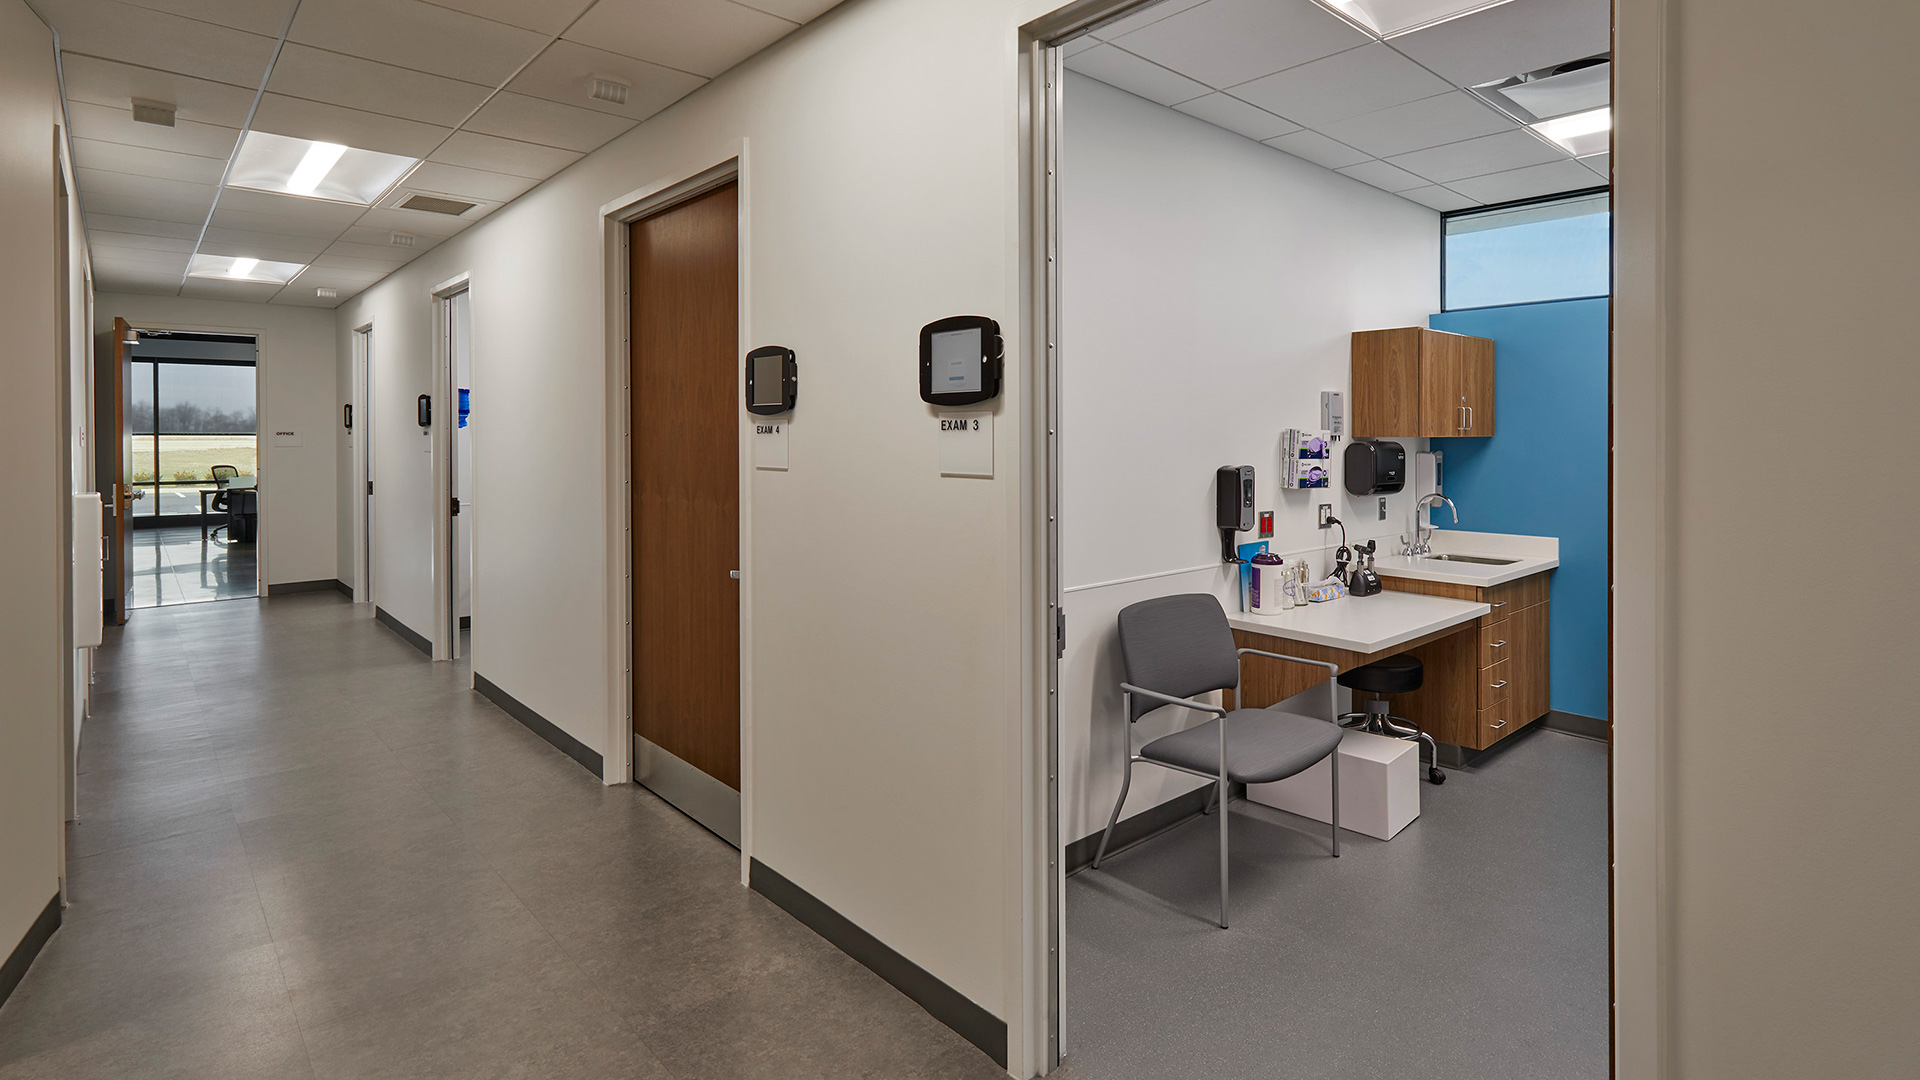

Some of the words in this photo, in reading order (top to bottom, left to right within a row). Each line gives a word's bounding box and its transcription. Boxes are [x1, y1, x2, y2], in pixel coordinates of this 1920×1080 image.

[756, 425, 773, 434] EXAM
[775, 425, 780, 434] 4
[941, 419, 968, 431] EXAM
[972, 419, 979, 431] 3
